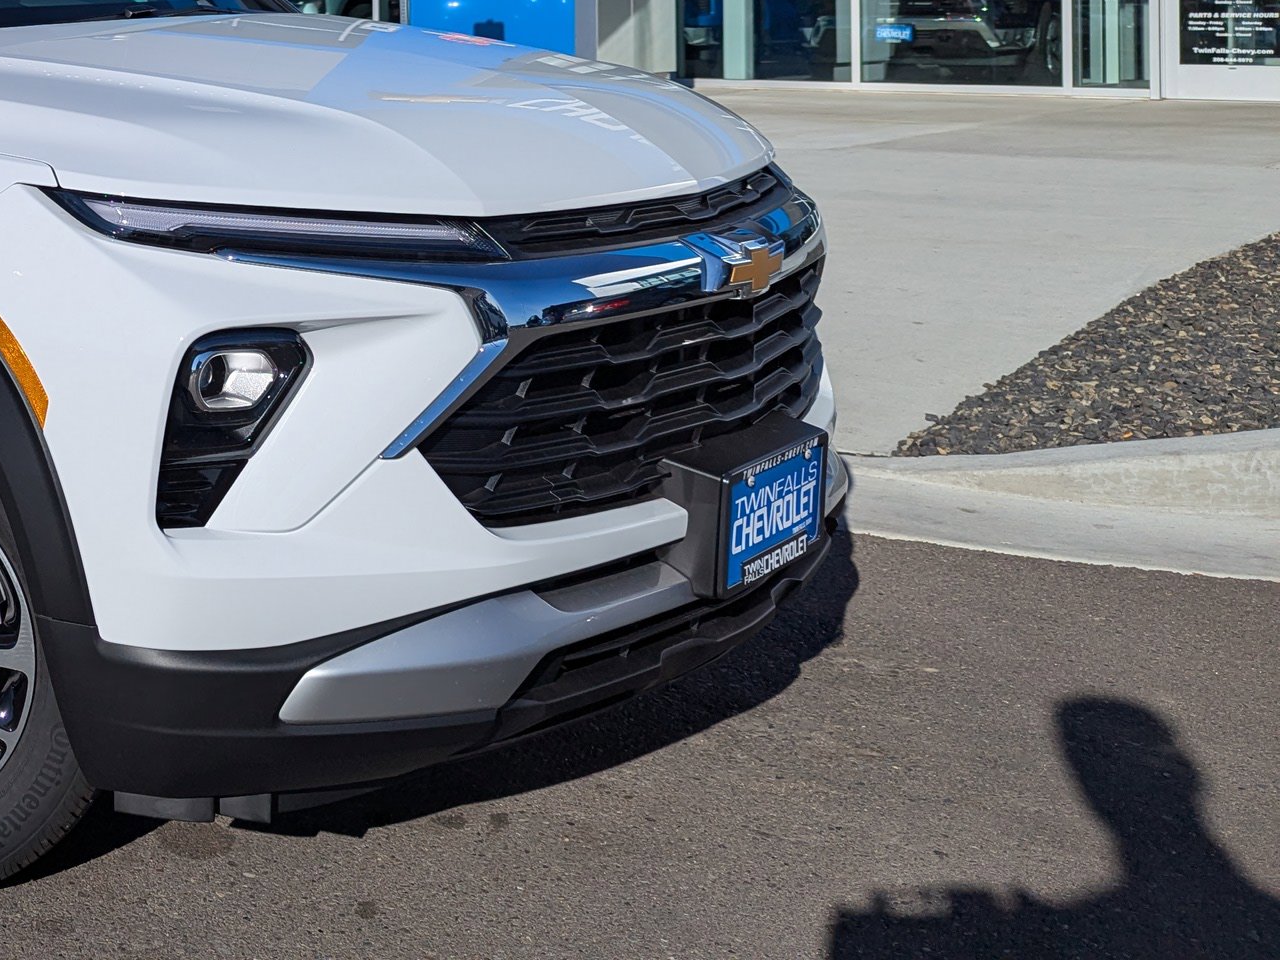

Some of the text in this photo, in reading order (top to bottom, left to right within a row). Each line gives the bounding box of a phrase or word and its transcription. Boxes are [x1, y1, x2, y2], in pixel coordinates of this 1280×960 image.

[735, 460, 818, 519] TWINFALLS
[731, 480, 817, 556] CHEVROLET
[743, 557, 765, 576] TWIN
[763, 534, 808, 574] CHEVROLET
[743, 567, 765, 586] FALLS
